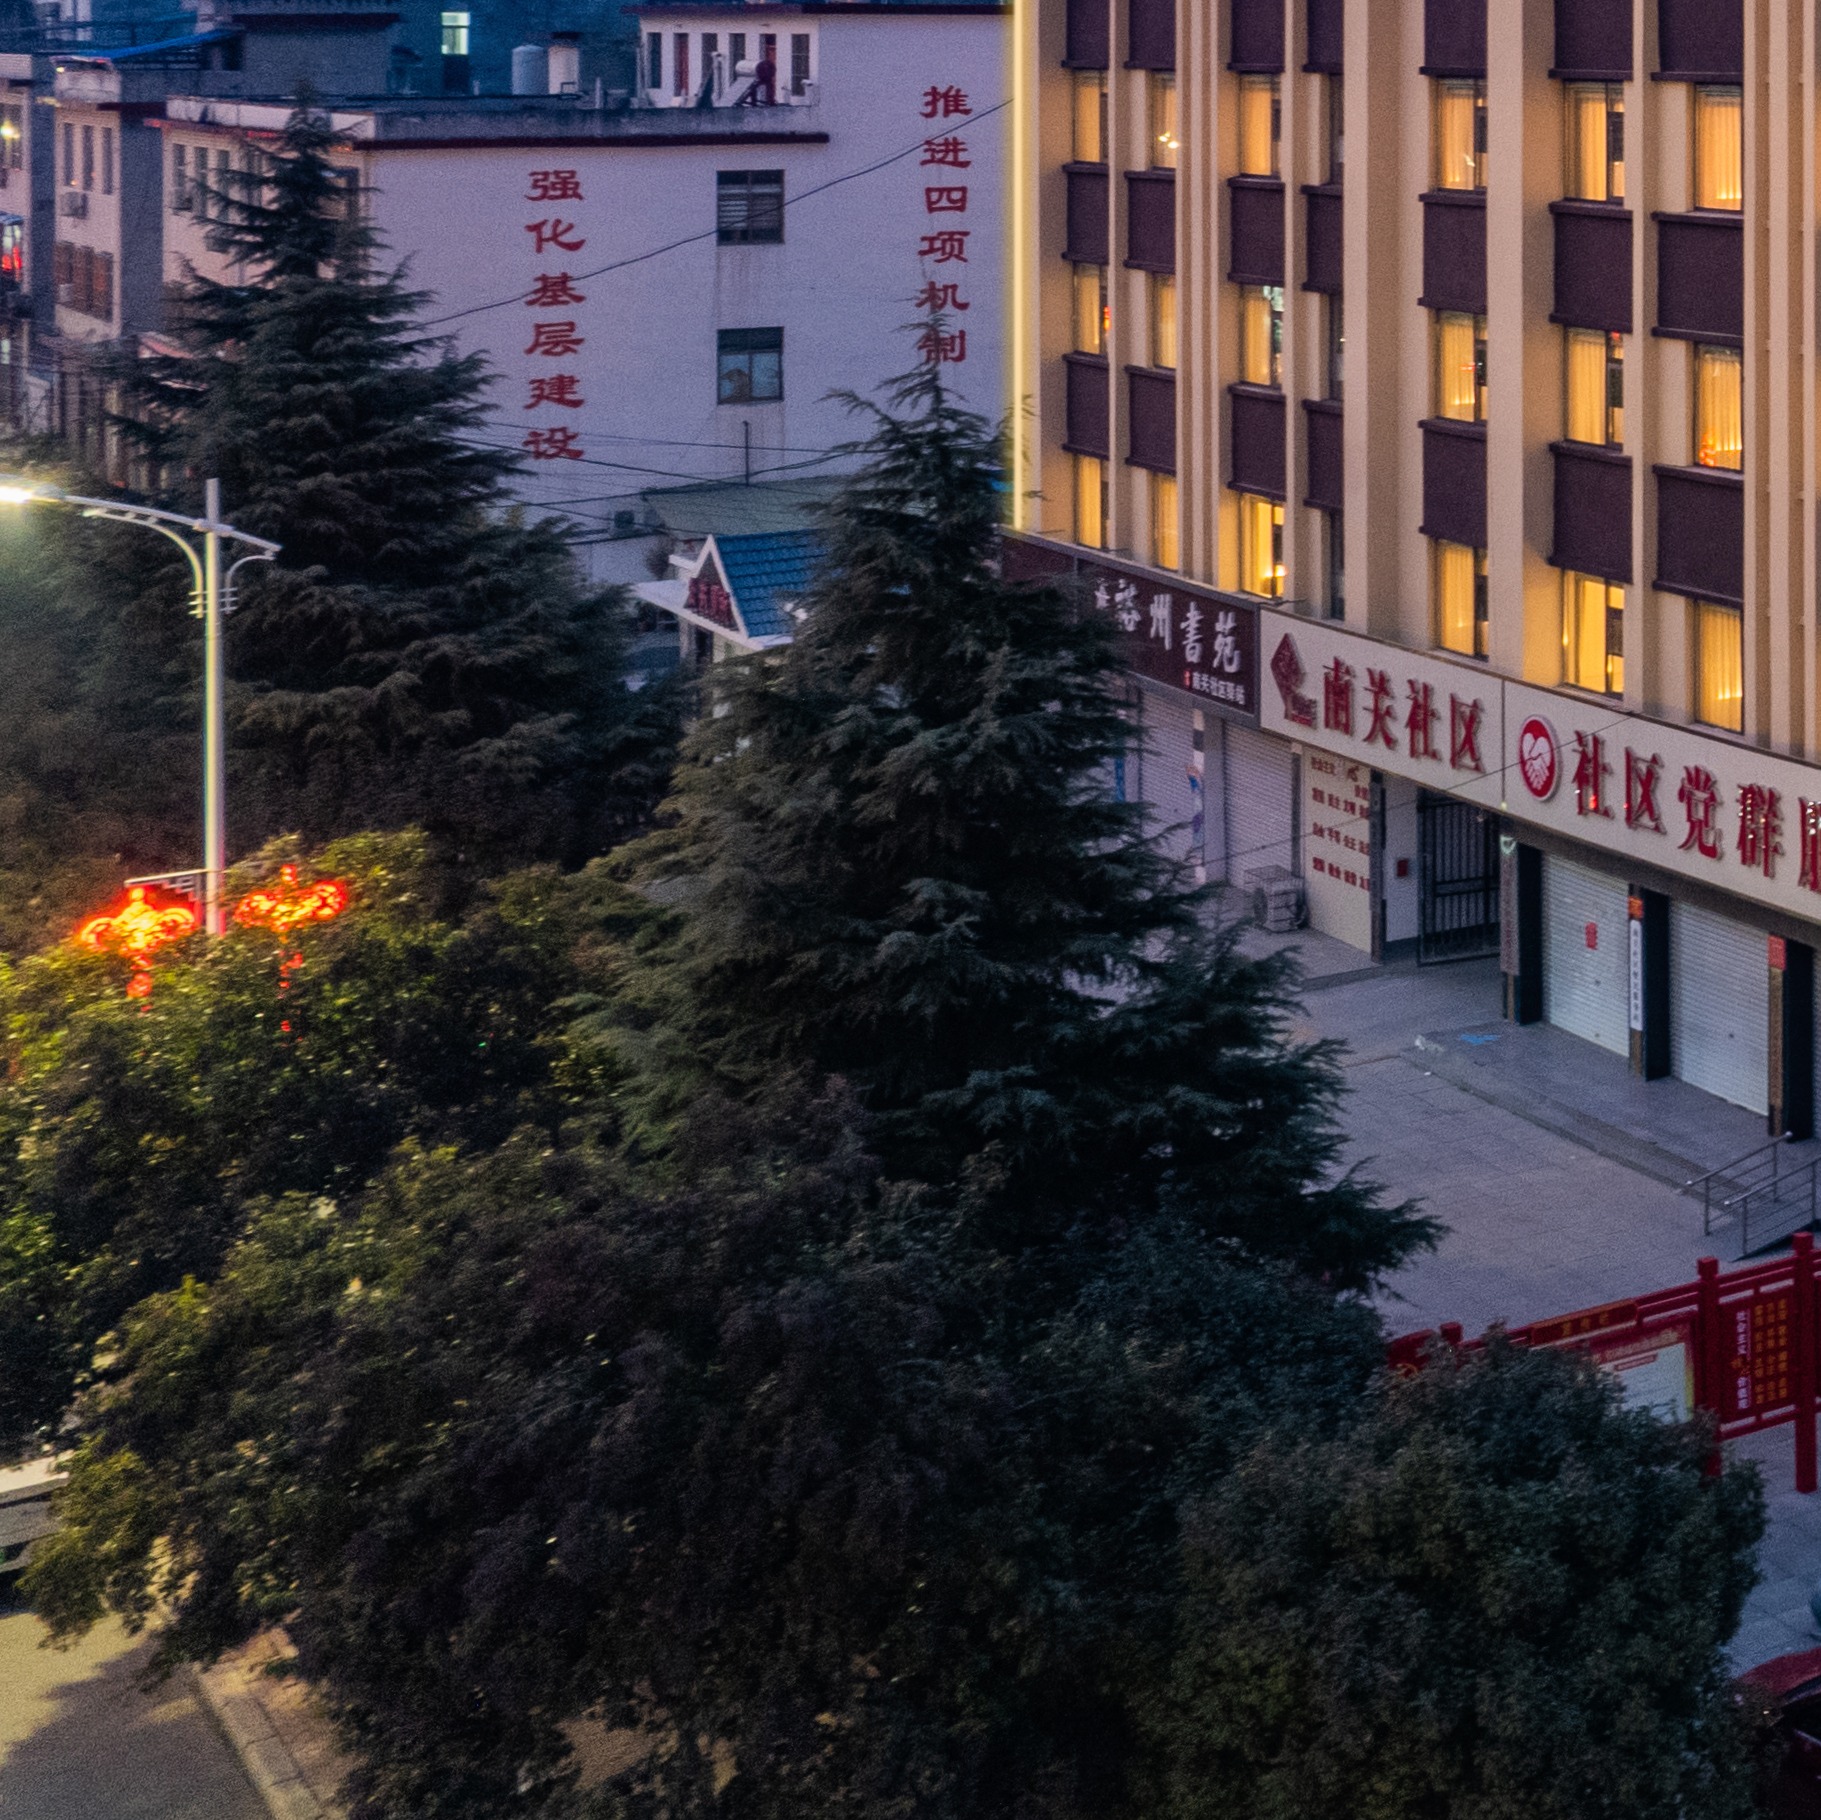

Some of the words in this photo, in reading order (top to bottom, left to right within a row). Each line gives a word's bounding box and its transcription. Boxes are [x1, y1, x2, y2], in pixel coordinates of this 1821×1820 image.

[523, 169, 586, 461] 强化基层建设
[915, 85, 973, 364] 推进四项机制
[1323, 656, 1487, 775] 南关社区
